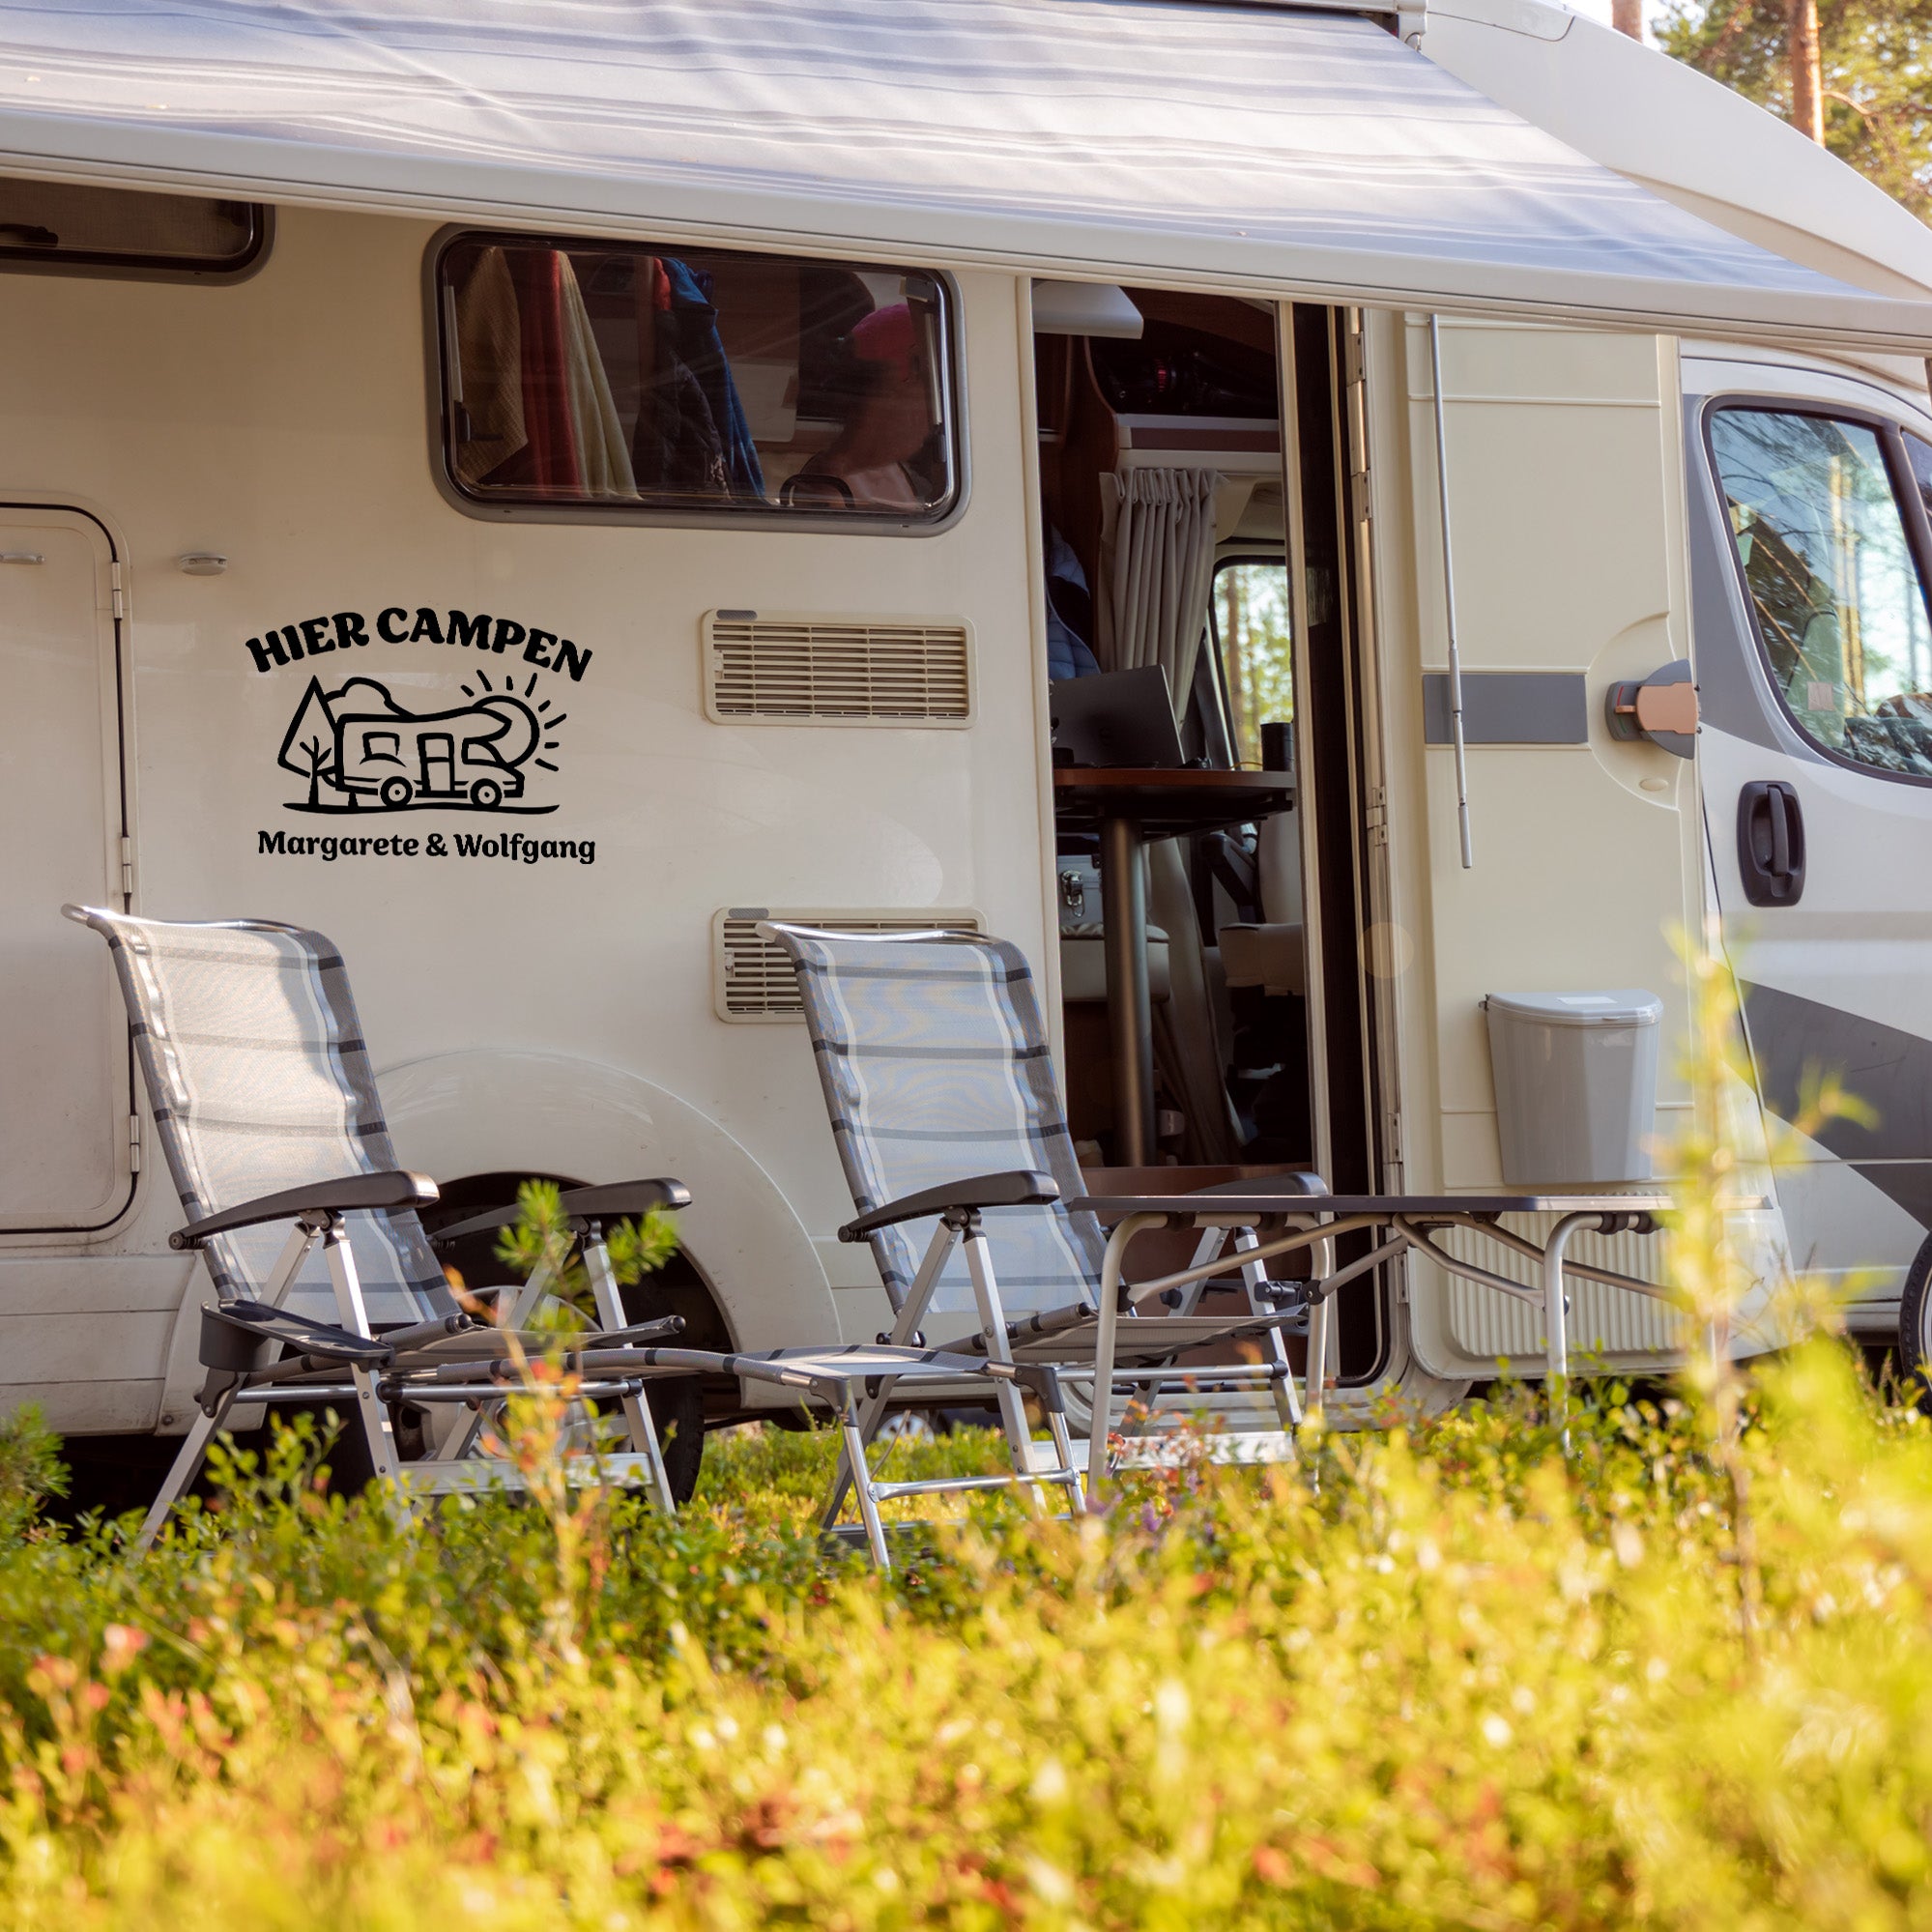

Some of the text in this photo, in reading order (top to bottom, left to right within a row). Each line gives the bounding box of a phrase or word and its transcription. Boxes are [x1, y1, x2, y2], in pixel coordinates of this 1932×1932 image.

[245, 607, 593, 682] HIER CAMPEN
[257, 830, 596, 865] Margarete & Wolfgang
